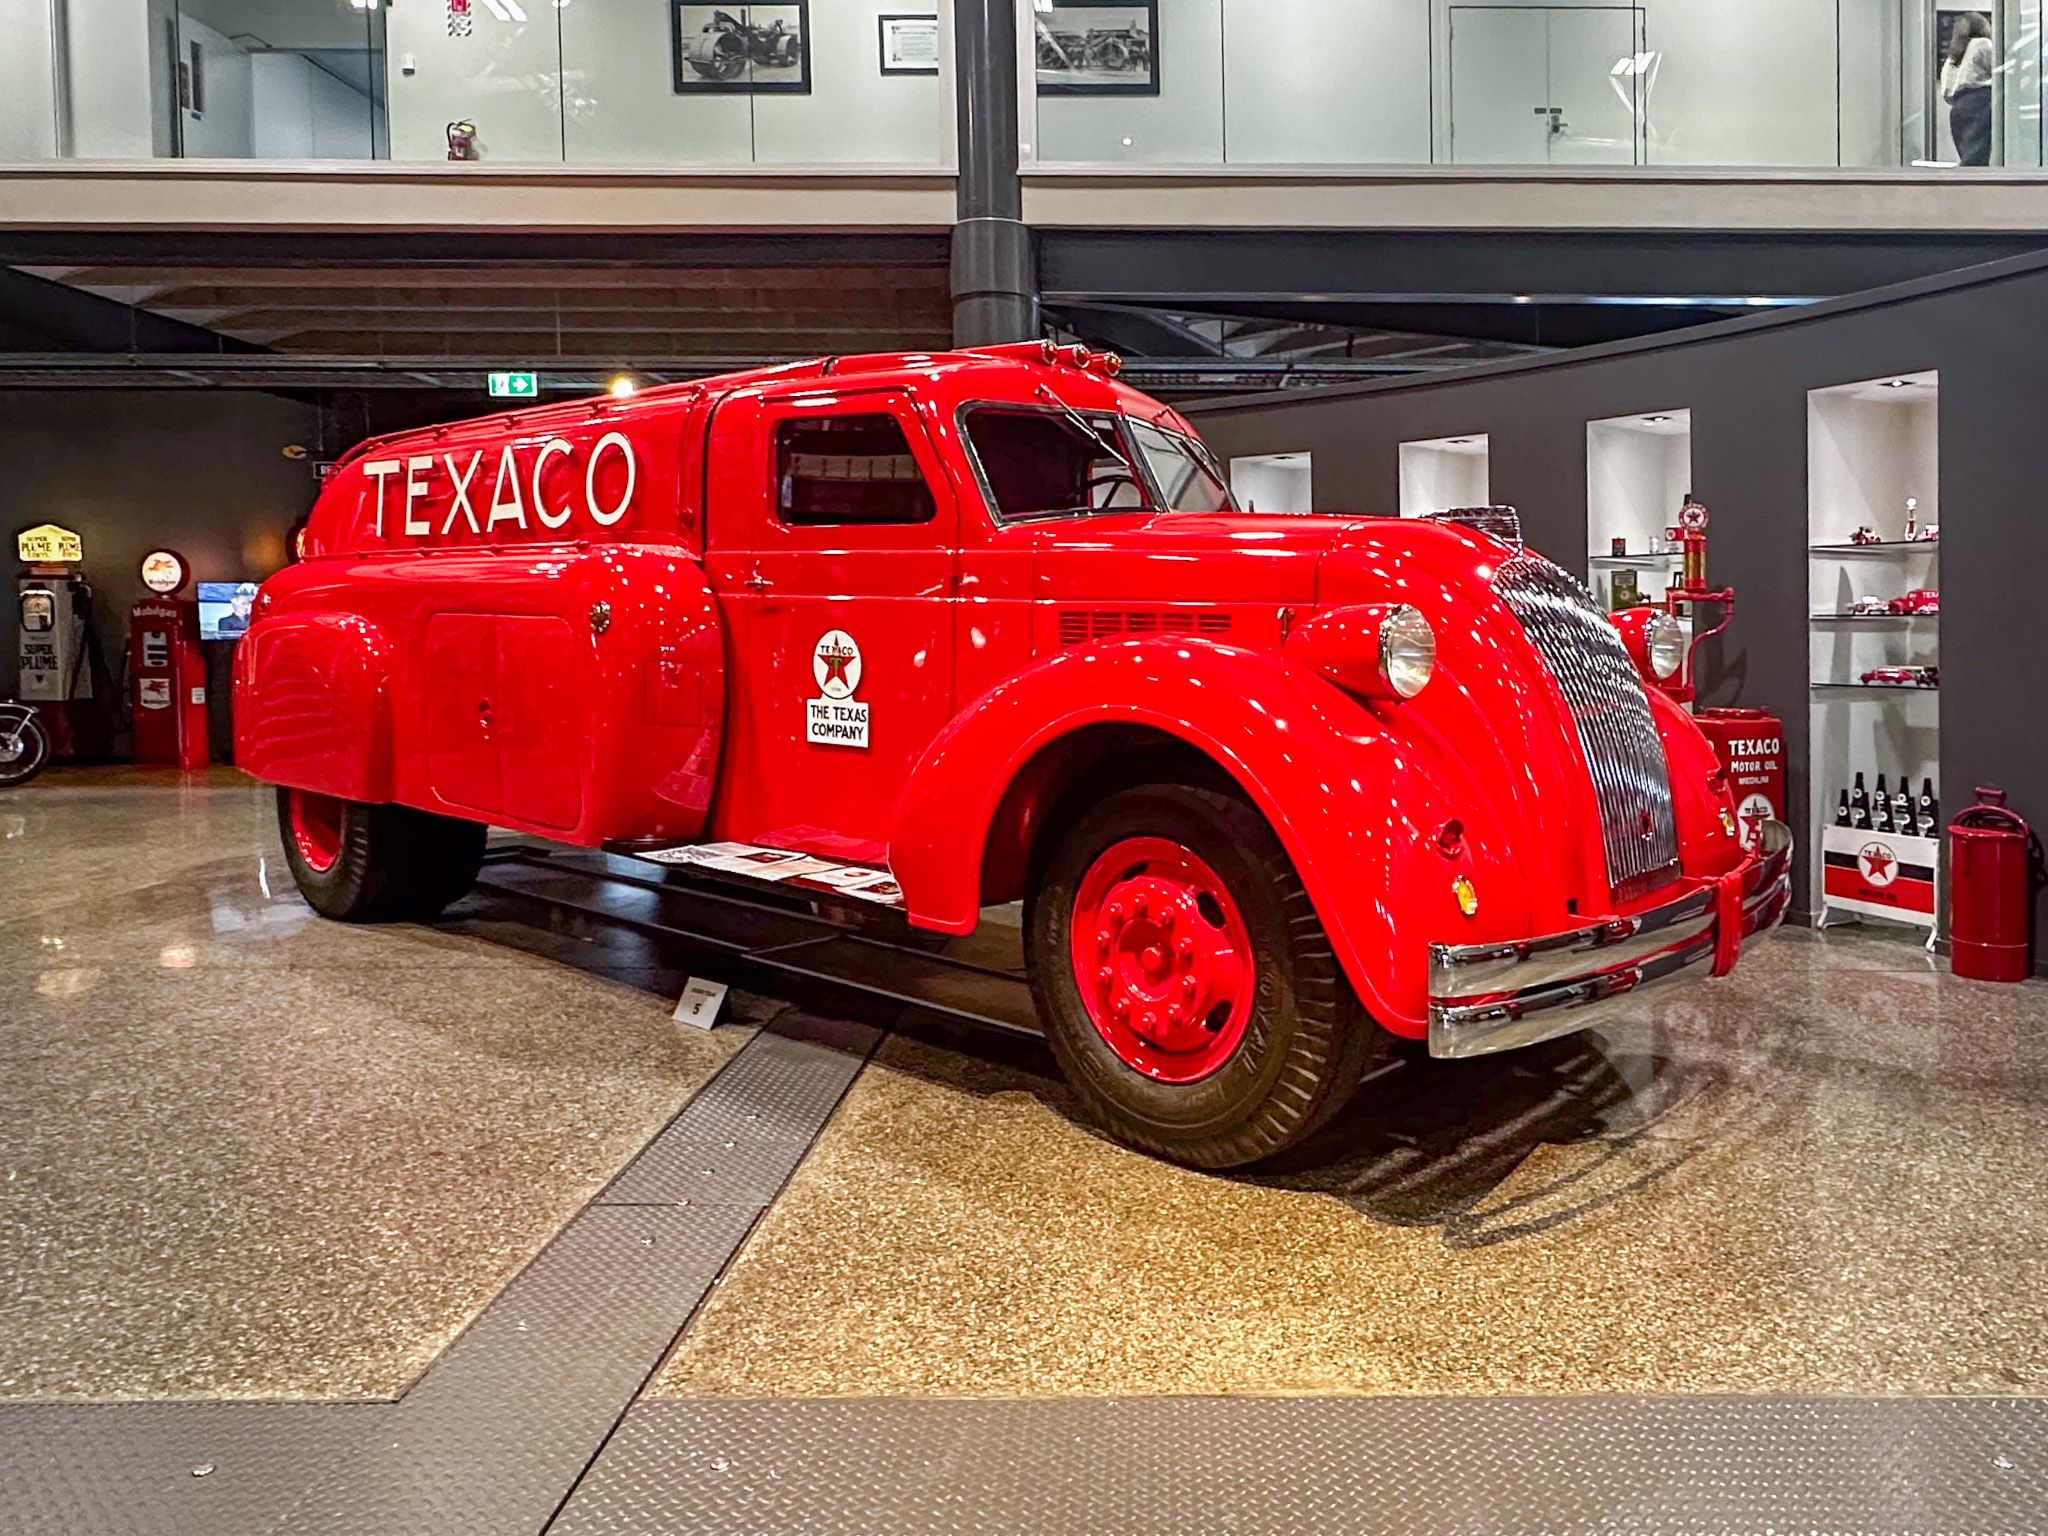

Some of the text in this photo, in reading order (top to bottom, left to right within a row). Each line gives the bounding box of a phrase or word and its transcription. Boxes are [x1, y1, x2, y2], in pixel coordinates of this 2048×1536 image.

[362, 432, 636, 538] TEXACO
[820, 645, 854, 656] TEXACO
[810, 704, 867, 722] THE TEXAS
[811, 722, 864, 741] COMPANY
[1728, 737, 1780, 756] TEXACO
[1730, 760, 1778, 773] MOTOR OIL
[692, 1003, 702, 1015] 5
